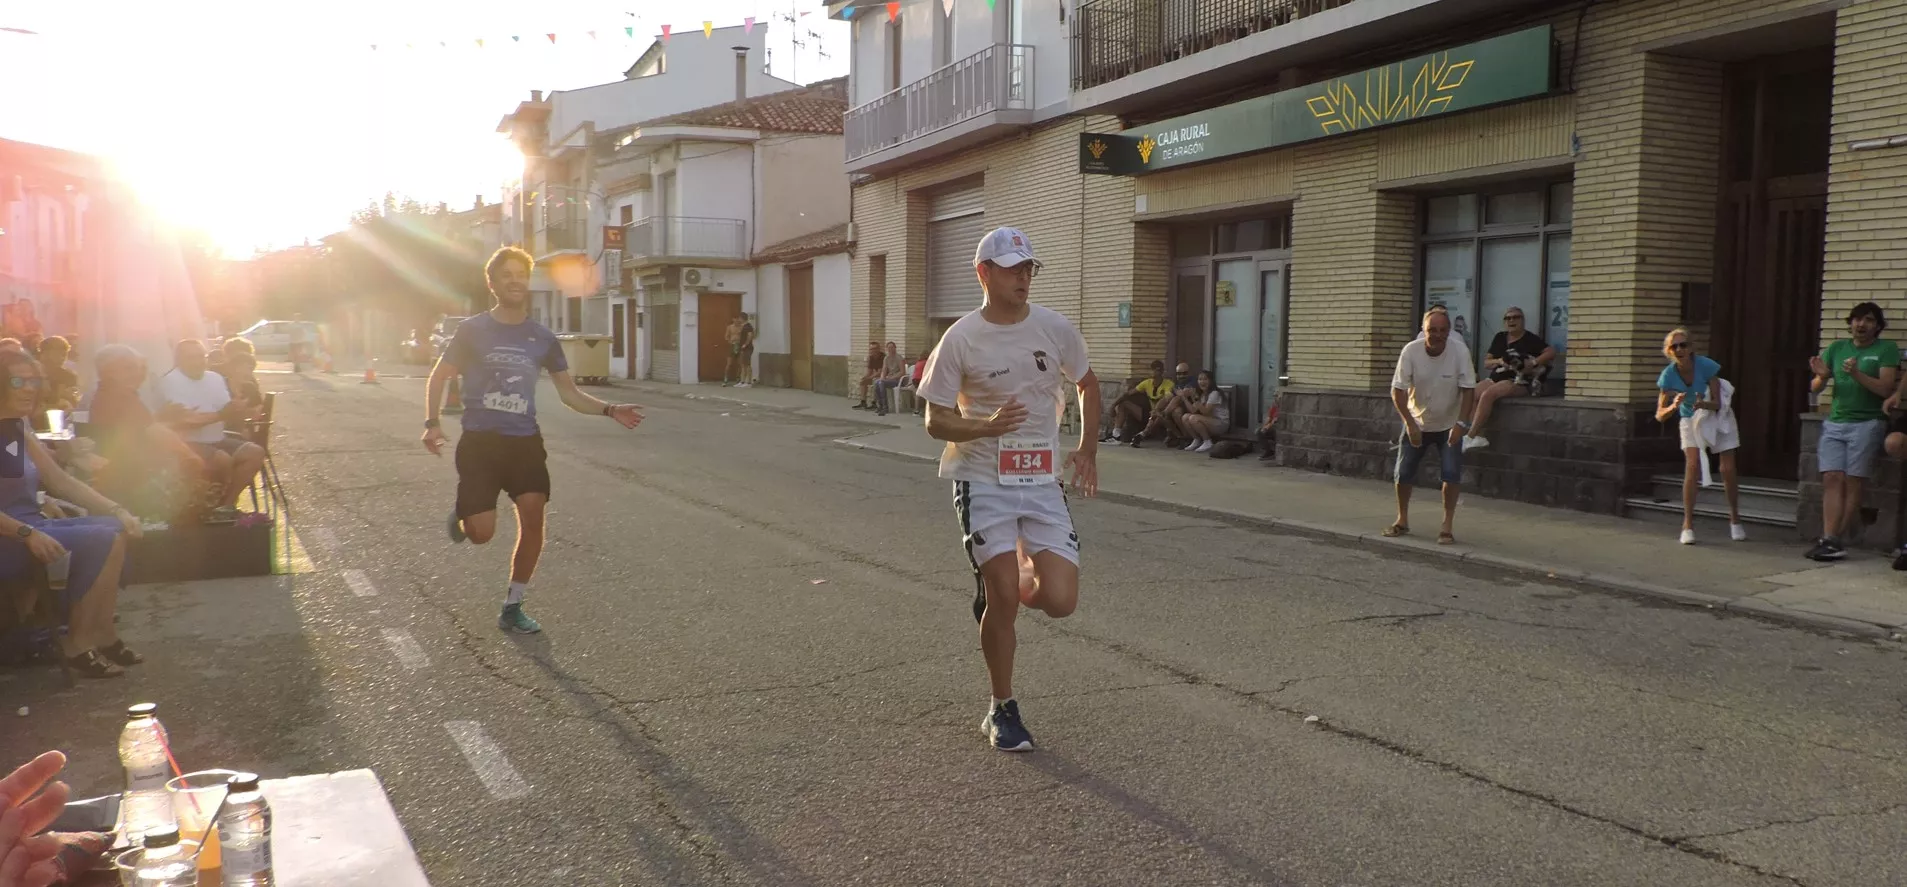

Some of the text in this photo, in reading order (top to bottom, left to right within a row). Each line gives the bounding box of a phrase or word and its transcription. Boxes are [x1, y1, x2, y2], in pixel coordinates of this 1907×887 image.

[1157, 123, 1210, 147] CAJA RURAL
[1162, 141, 1205, 160] DE ARAGÓN
[492, 398, 519, 411] 1401
[1012, 453, 1042, 469] 134
